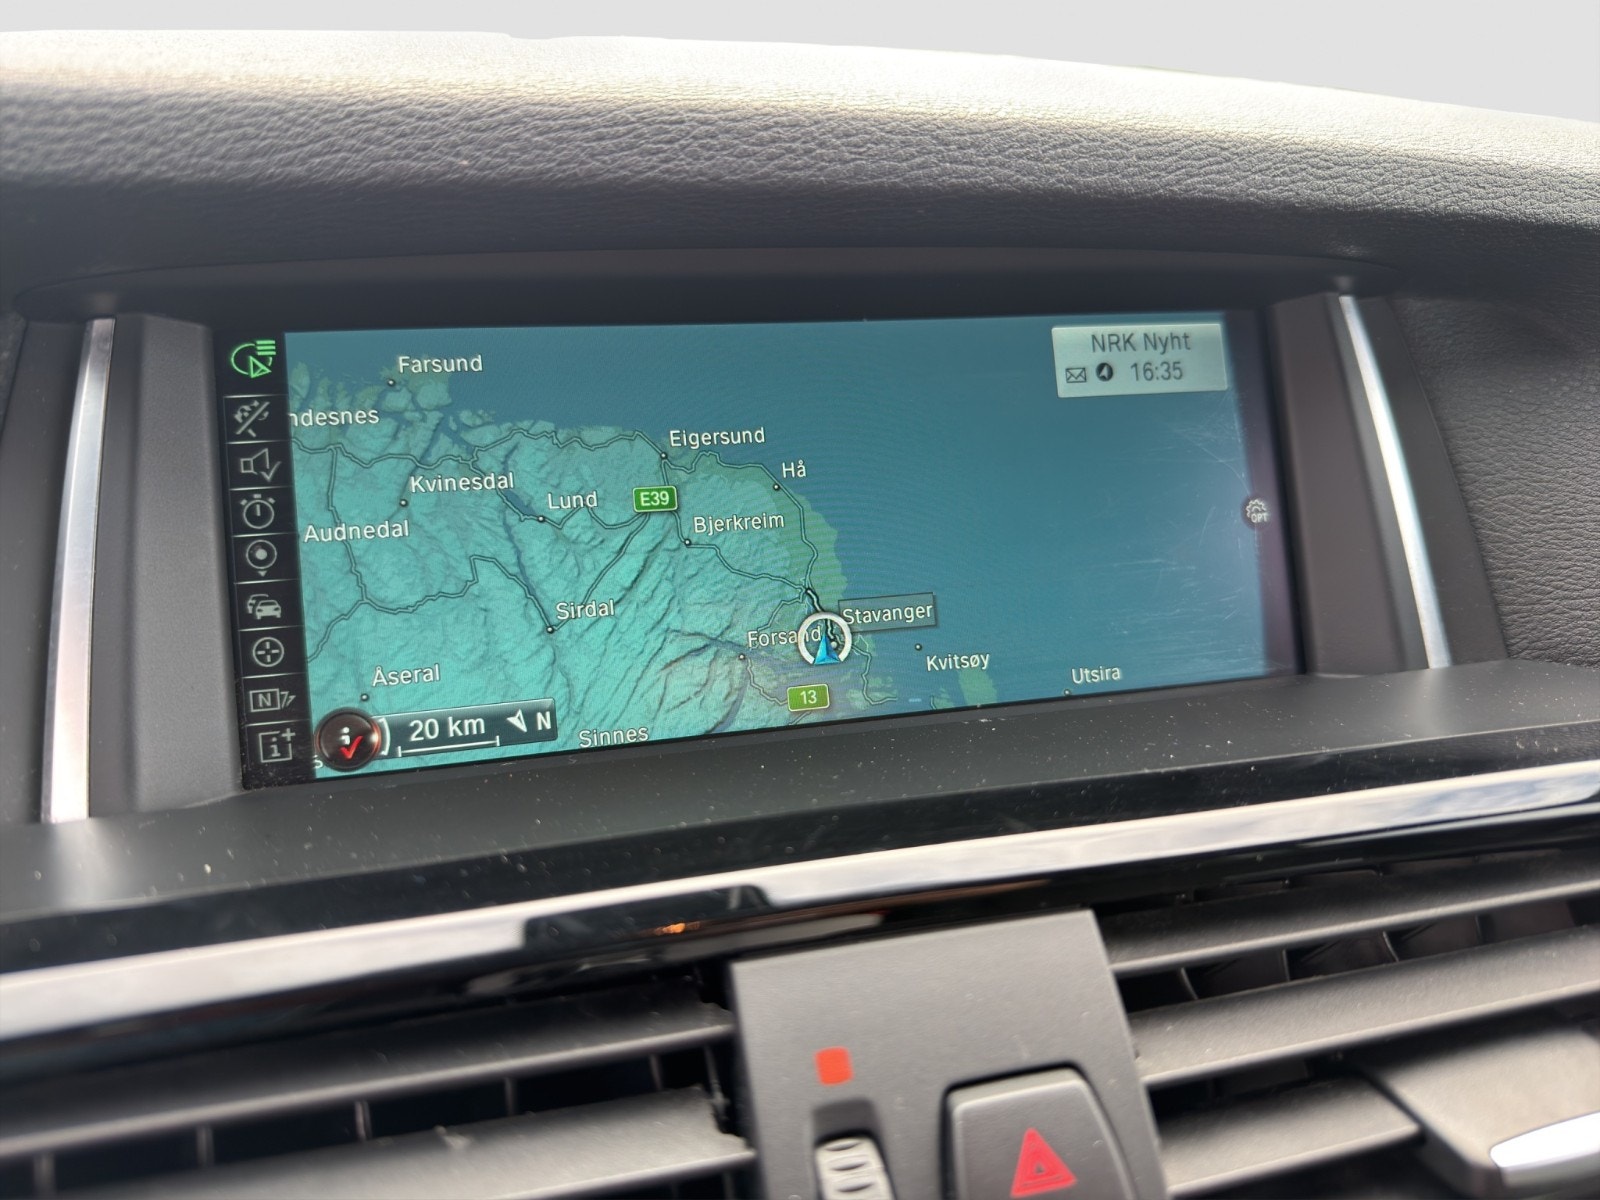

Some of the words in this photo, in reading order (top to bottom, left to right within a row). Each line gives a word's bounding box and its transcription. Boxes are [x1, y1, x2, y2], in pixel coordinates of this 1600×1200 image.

[1091, 333, 1136, 353] NRK
[1143, 332, 1191, 354] Nyht
[398, 354, 483, 373] Farsund
[1130, 361, 1183, 381] 16:35
[669, 427, 766, 449] Eigersund
[782, 460, 807, 478] Hå
[410, 472, 514, 493] Kvinesdal
[548, 491, 598, 509] Lund
[640, 490, 670, 507] E39
[693, 512, 785, 536] Bjerkreim
[1250, 512, 1268, 523] OPT
[304, 520, 410, 542] Audnedal
[556, 599, 615, 620] Sirdal
[842, 602, 933, 625] Stavanger
[926, 652, 990, 671] Kvitsøy
[371, 663, 441, 687] Åseral
[1071, 665, 1122, 684] Utsira
[800, 689, 818, 705] 13
[409, 719, 439, 741] 20
[449, 716, 486, 736] km
[536, 711, 552, 731] N
[578, 725, 649, 749] Sinnes
